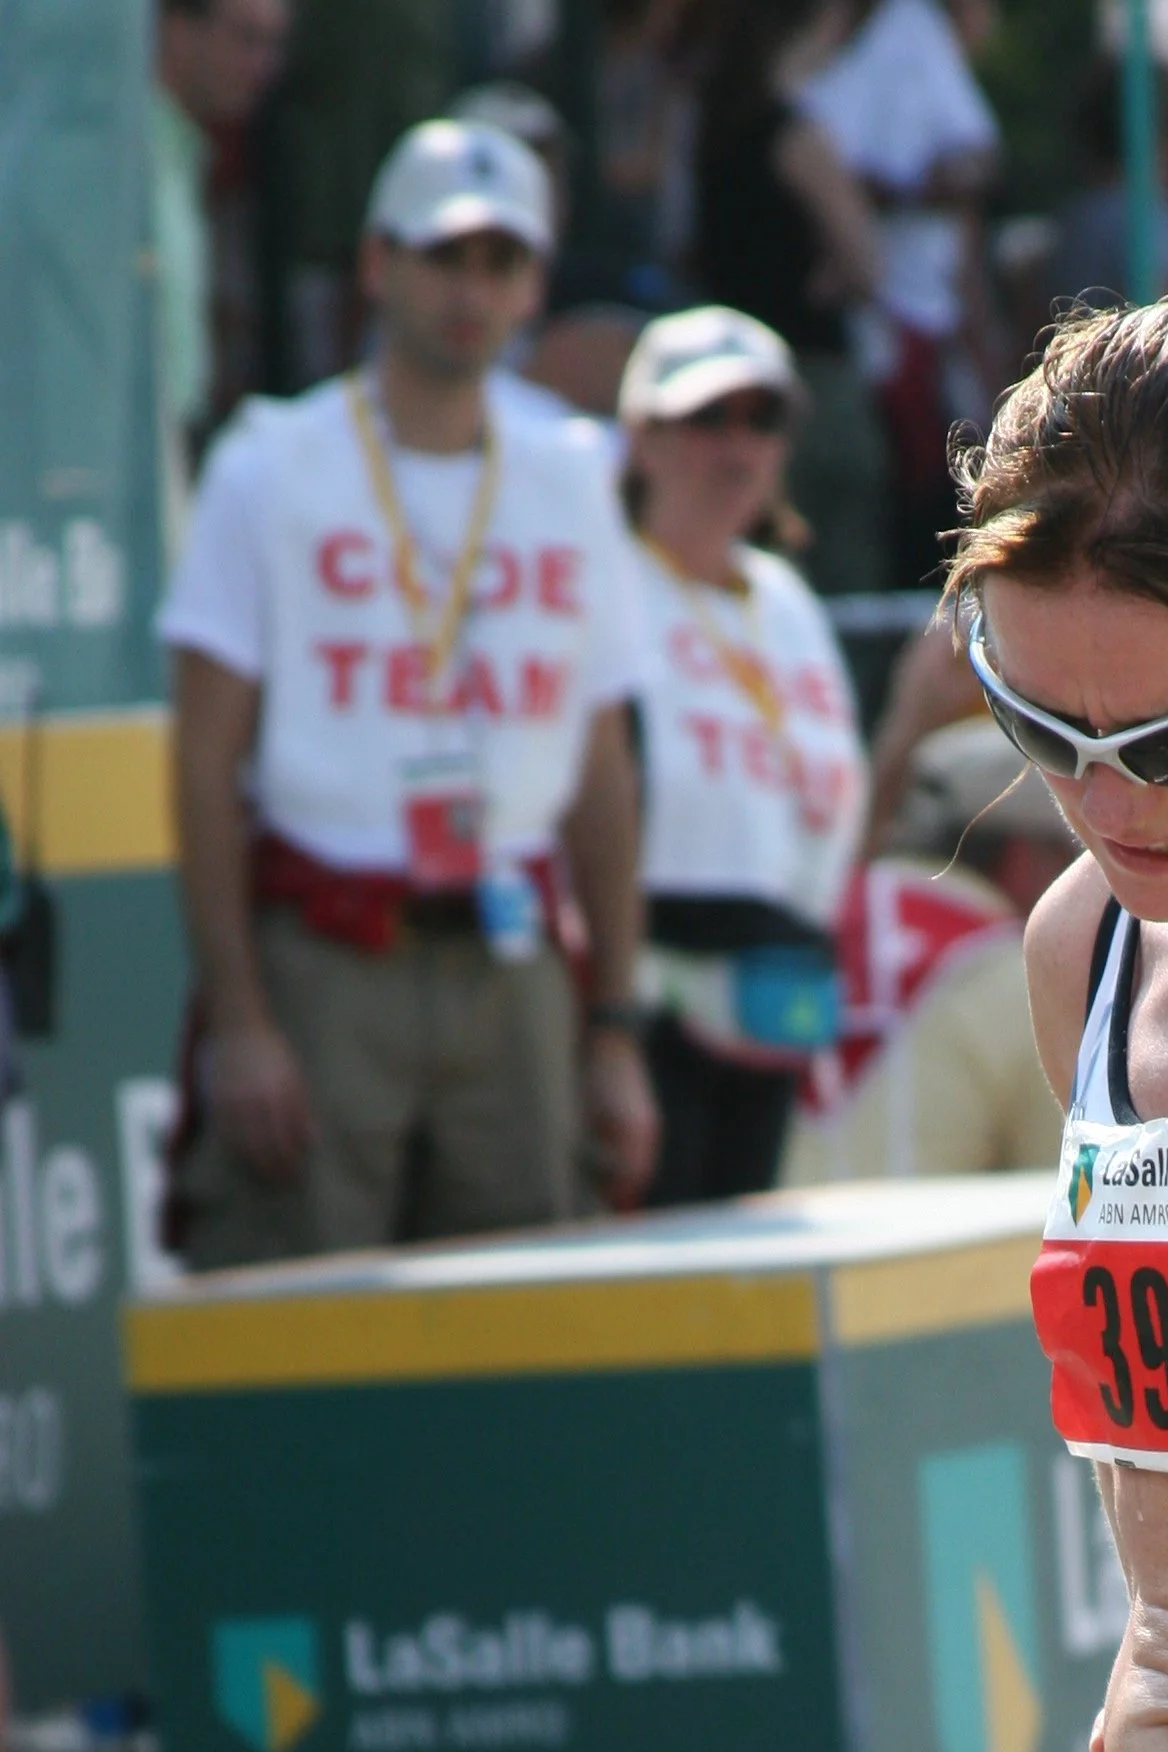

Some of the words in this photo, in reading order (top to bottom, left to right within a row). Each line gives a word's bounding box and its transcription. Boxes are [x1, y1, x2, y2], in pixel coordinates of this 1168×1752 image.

[1098, 1203, 1124, 1225] ABN
[344, 1612, 592, 1693] LaSalle
[605, 1598, 784, 1684] Bank
